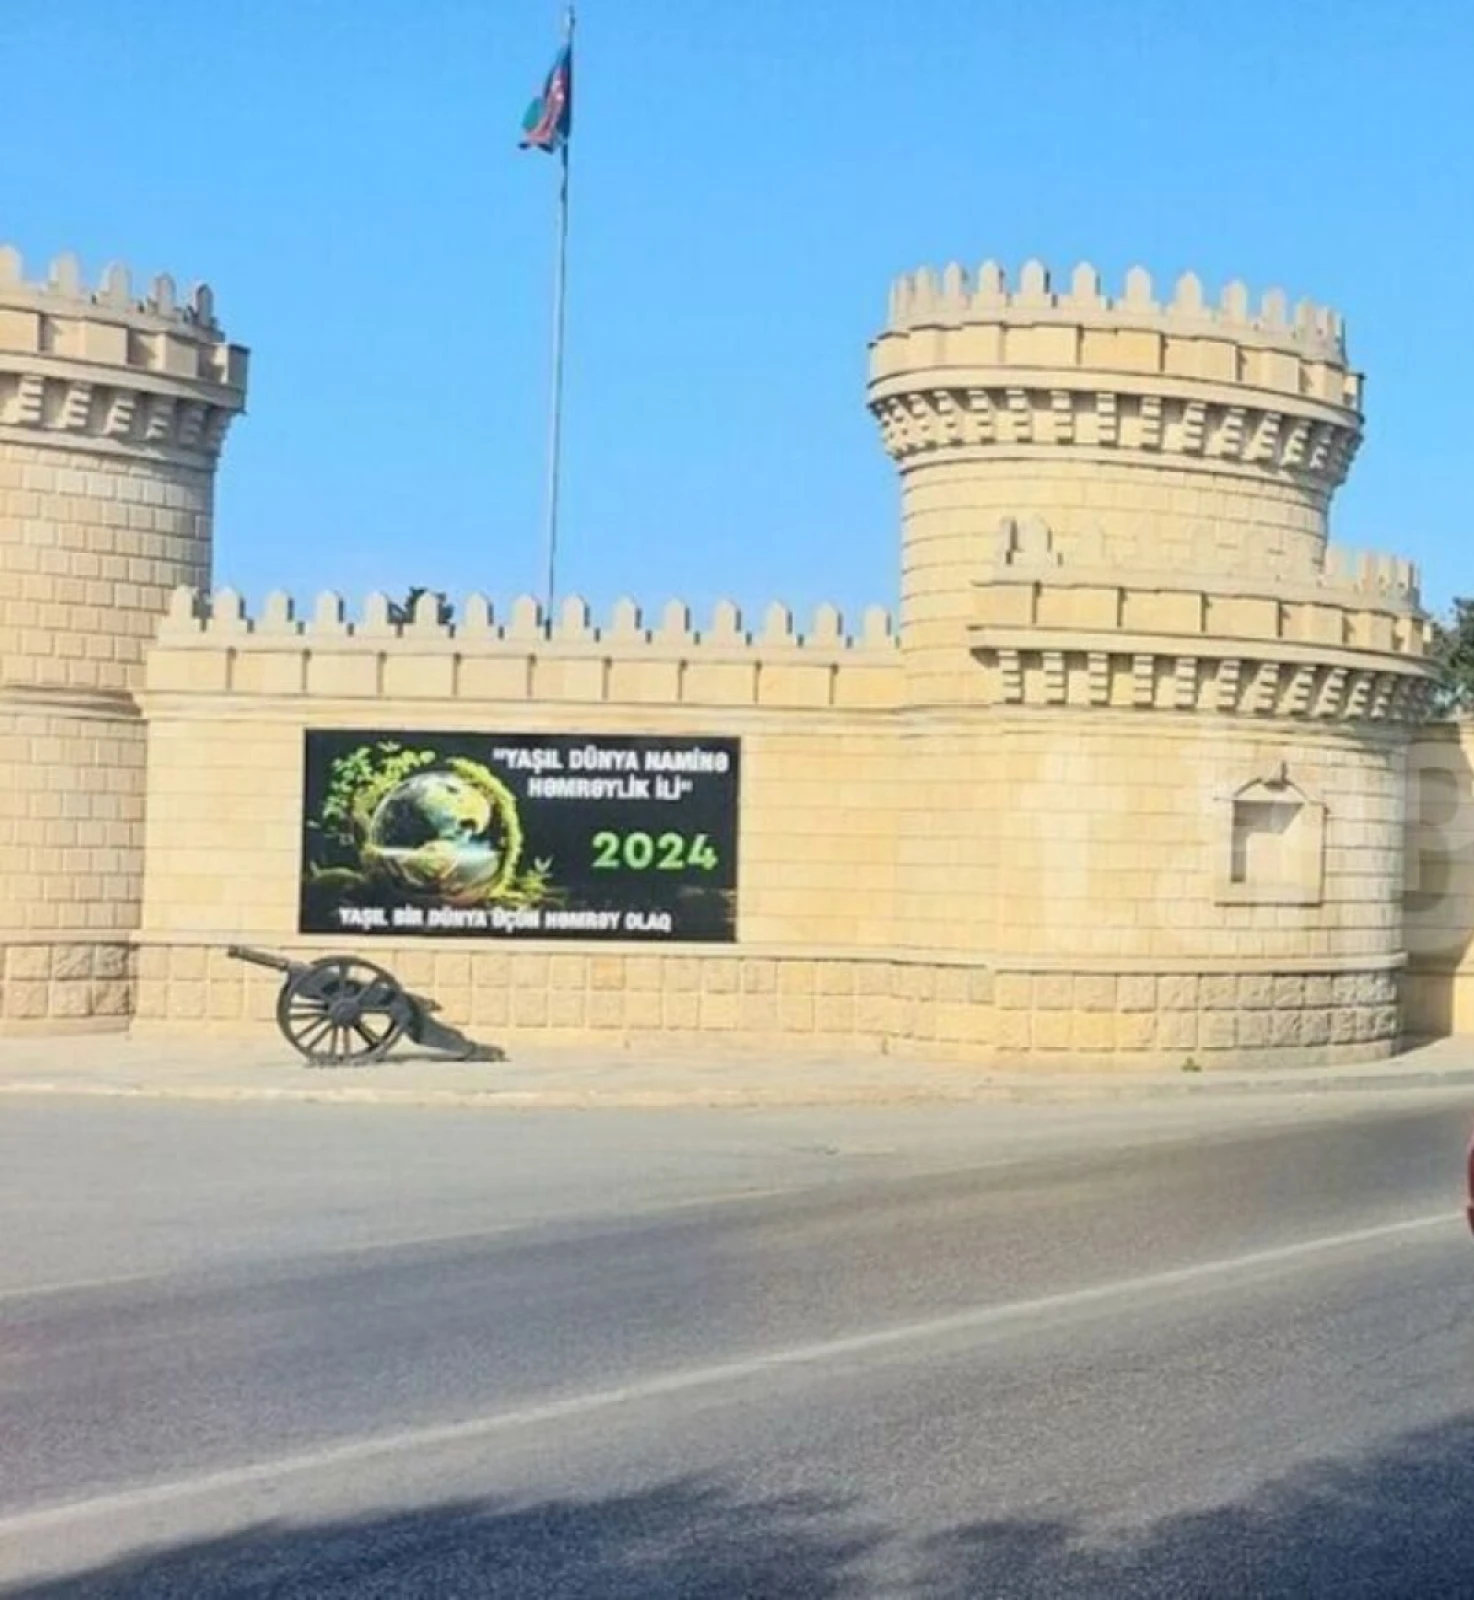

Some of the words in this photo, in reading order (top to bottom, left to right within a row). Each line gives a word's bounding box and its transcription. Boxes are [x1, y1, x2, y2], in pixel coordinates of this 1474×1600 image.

[569, 745, 639, 770] DÜNYA
[645, 747, 730, 772] NAMİNƏ
[527, 773, 650, 799] HƏMRƏYLİK
[592, 831, 719, 870] 2024
[339, 906, 387, 931] YAŞIL
[428, 905, 488, 927] DÜNYA
[624, 911, 672, 933] OLAQ
